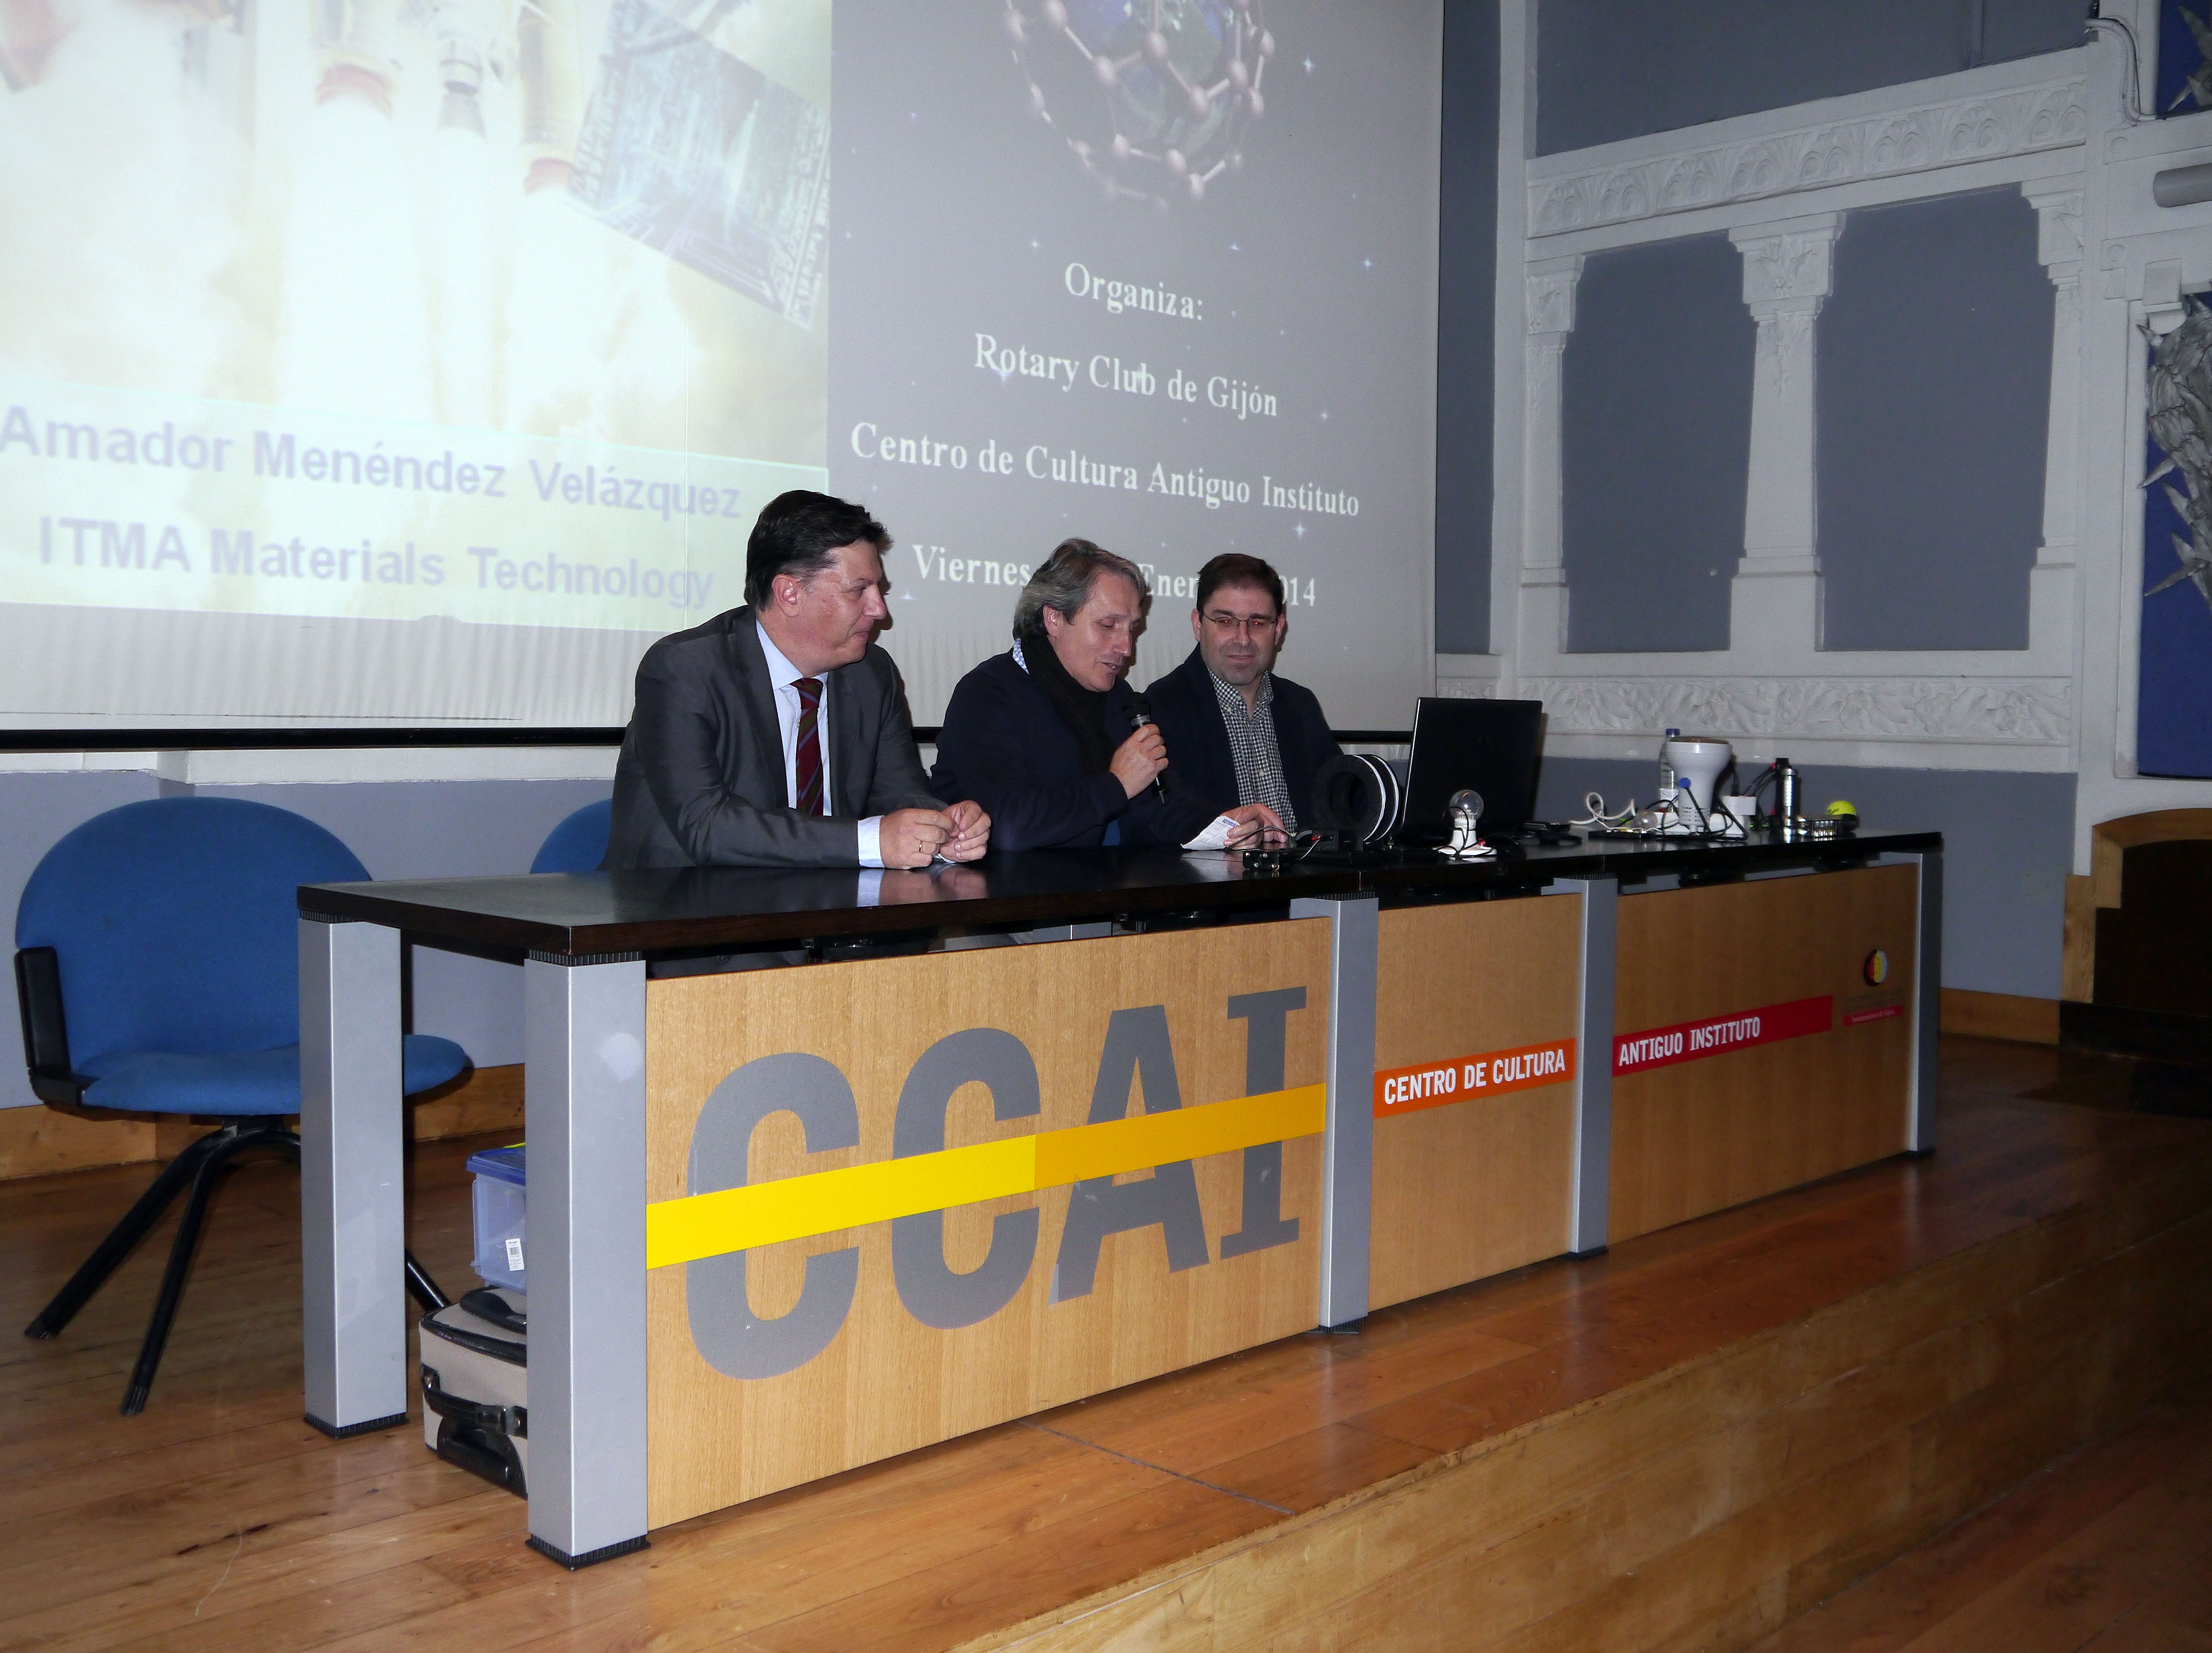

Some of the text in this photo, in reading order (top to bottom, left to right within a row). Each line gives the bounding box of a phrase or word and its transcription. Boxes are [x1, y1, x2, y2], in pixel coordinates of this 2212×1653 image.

[1065, 262, 1203, 321] Organiza:
[974, 333, 1277, 420] Rotary Club de Gijón
[0, 404, 741, 521] Amador Menéndez Velázquez
[851, 422, 1359, 516] Centro de Cultura Antiguo Instituto
[40, 516, 714, 610] ITMA Materials Technology
[912, 544, 1031, 586] Viernes
[1137, 563, 1201, 598] Ener
[1384, 1049, 1565, 1104] CENTRO DE CULTURA
[1619, 1017, 1761, 1066] ANTIGUO INSTITUTO
[686, 986, 1307, 1380] CCAI
